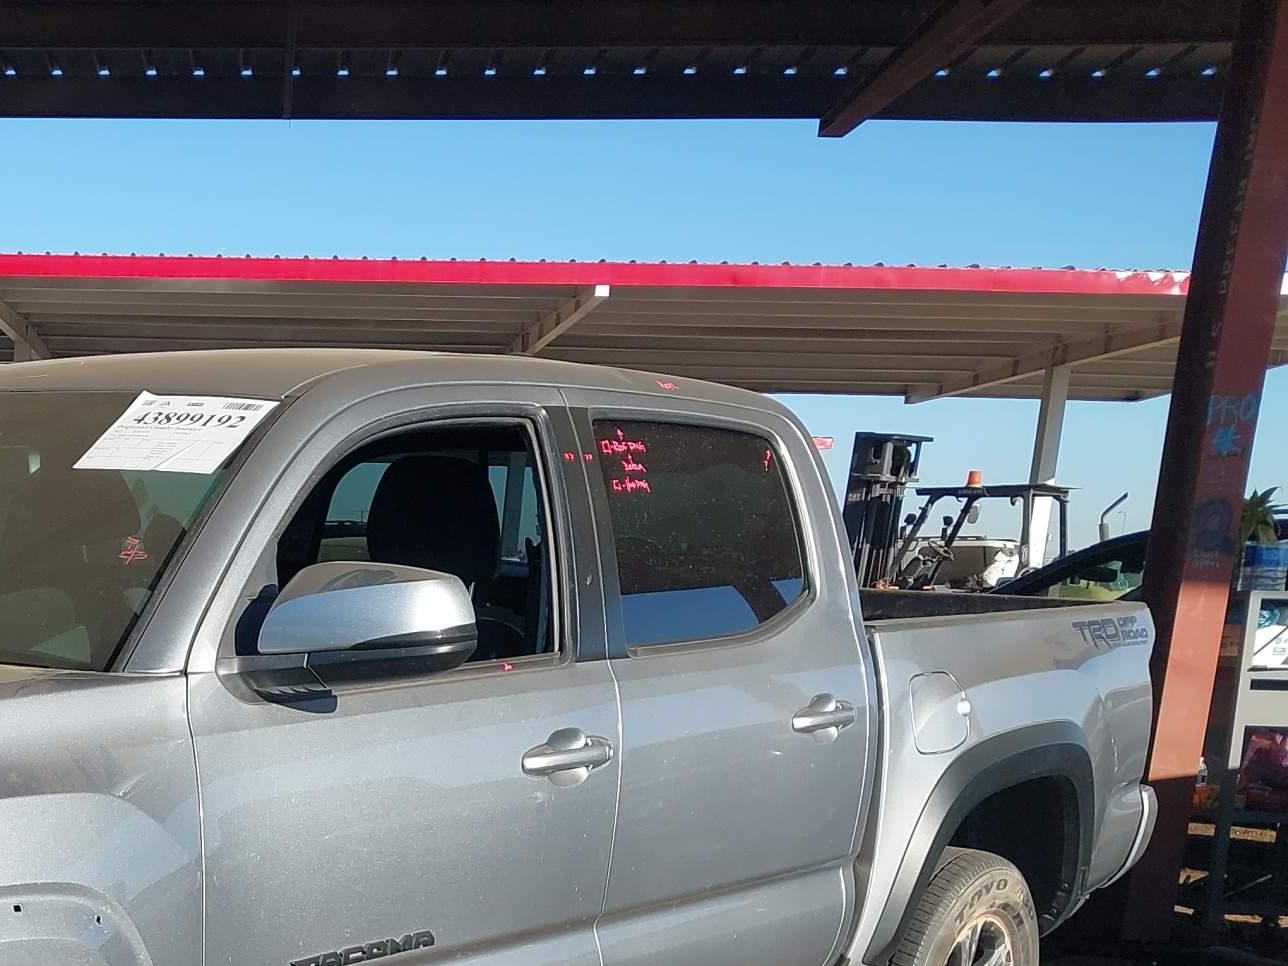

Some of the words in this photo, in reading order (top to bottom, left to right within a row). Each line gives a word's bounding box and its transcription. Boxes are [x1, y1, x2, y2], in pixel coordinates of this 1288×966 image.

[132, 411, 246, 429] 43899192
[1072, 618, 1121, 650] TRD
[1121, 627, 1149, 641] ROAD
